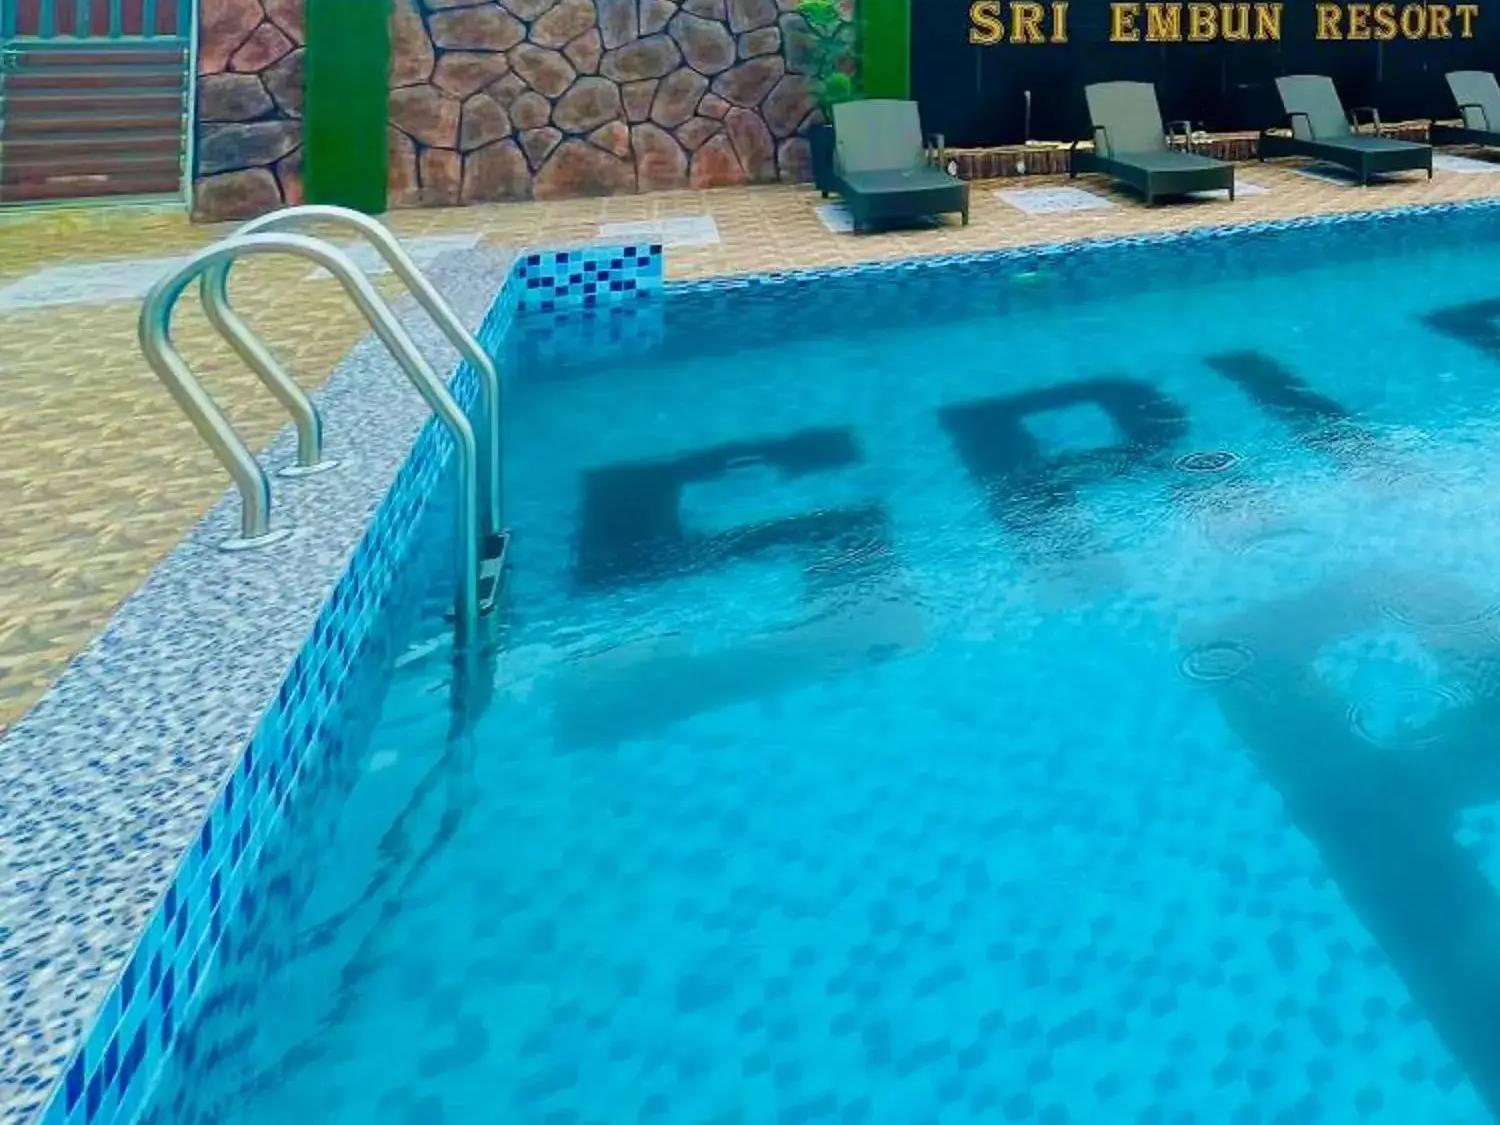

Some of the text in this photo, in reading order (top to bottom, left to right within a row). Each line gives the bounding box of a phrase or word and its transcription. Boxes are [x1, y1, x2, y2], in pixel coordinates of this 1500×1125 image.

[969, 0, 1479, 45] SRI EMBUN RESORT
